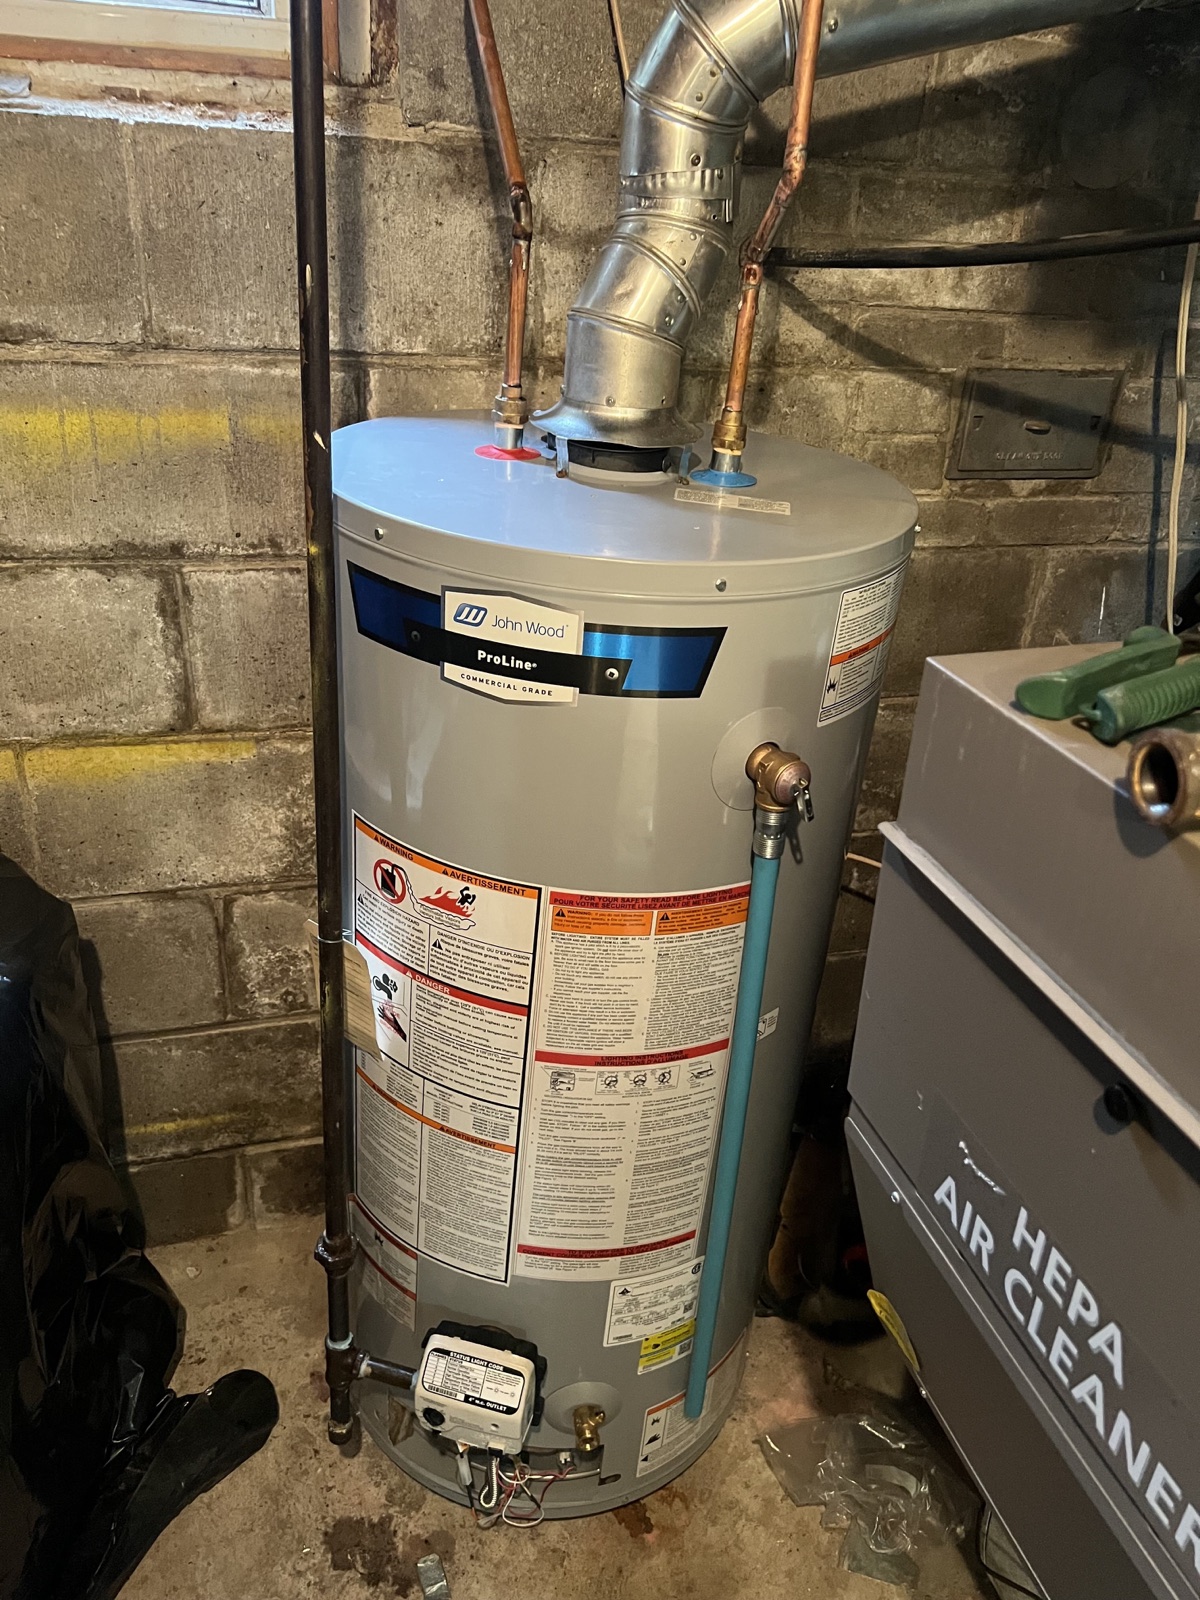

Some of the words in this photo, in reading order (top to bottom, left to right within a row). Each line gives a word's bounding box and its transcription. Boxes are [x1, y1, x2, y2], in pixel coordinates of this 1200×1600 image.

[491, 614, 523, 632] John
[525, 620, 565, 638] Wood
[460, 673, 518, 690] COMMERCIAL
[522, 686, 553, 696] GRADE
[379, 836, 414, 861] WARNING
[450, 870, 527, 896] AVERTISSEMENT
[553, 897, 574, 906] POUR
[576, 900, 600, 908] VOTRE
[692, 897, 718, 906] METTRE
[597, 895, 618, 903] YOUR
[672, 893, 700, 902] BEFORE
[702, 888, 733, 899] LIGHTING
[437, 930, 457, 942] DANGER
[457, 937, 484, 951] D'INCENDIE
[486, 946, 494, 954] OU
[495, 949, 530, 961] D'EXPLOSION
[415, 974, 450, 994] DANGER
[635, 1050, 683, 1060] INSTRUCTIONS
[934, 1176, 994, 1275] AIR
[1012, 1206, 1124, 1389] HEPA
[449, 1351, 470, 1362] STATUS
[471, 1357, 488, 1367] LIGHT
[488, 1362, 504, 1371] CODE
[486, 1402, 507, 1412] OUTLET
